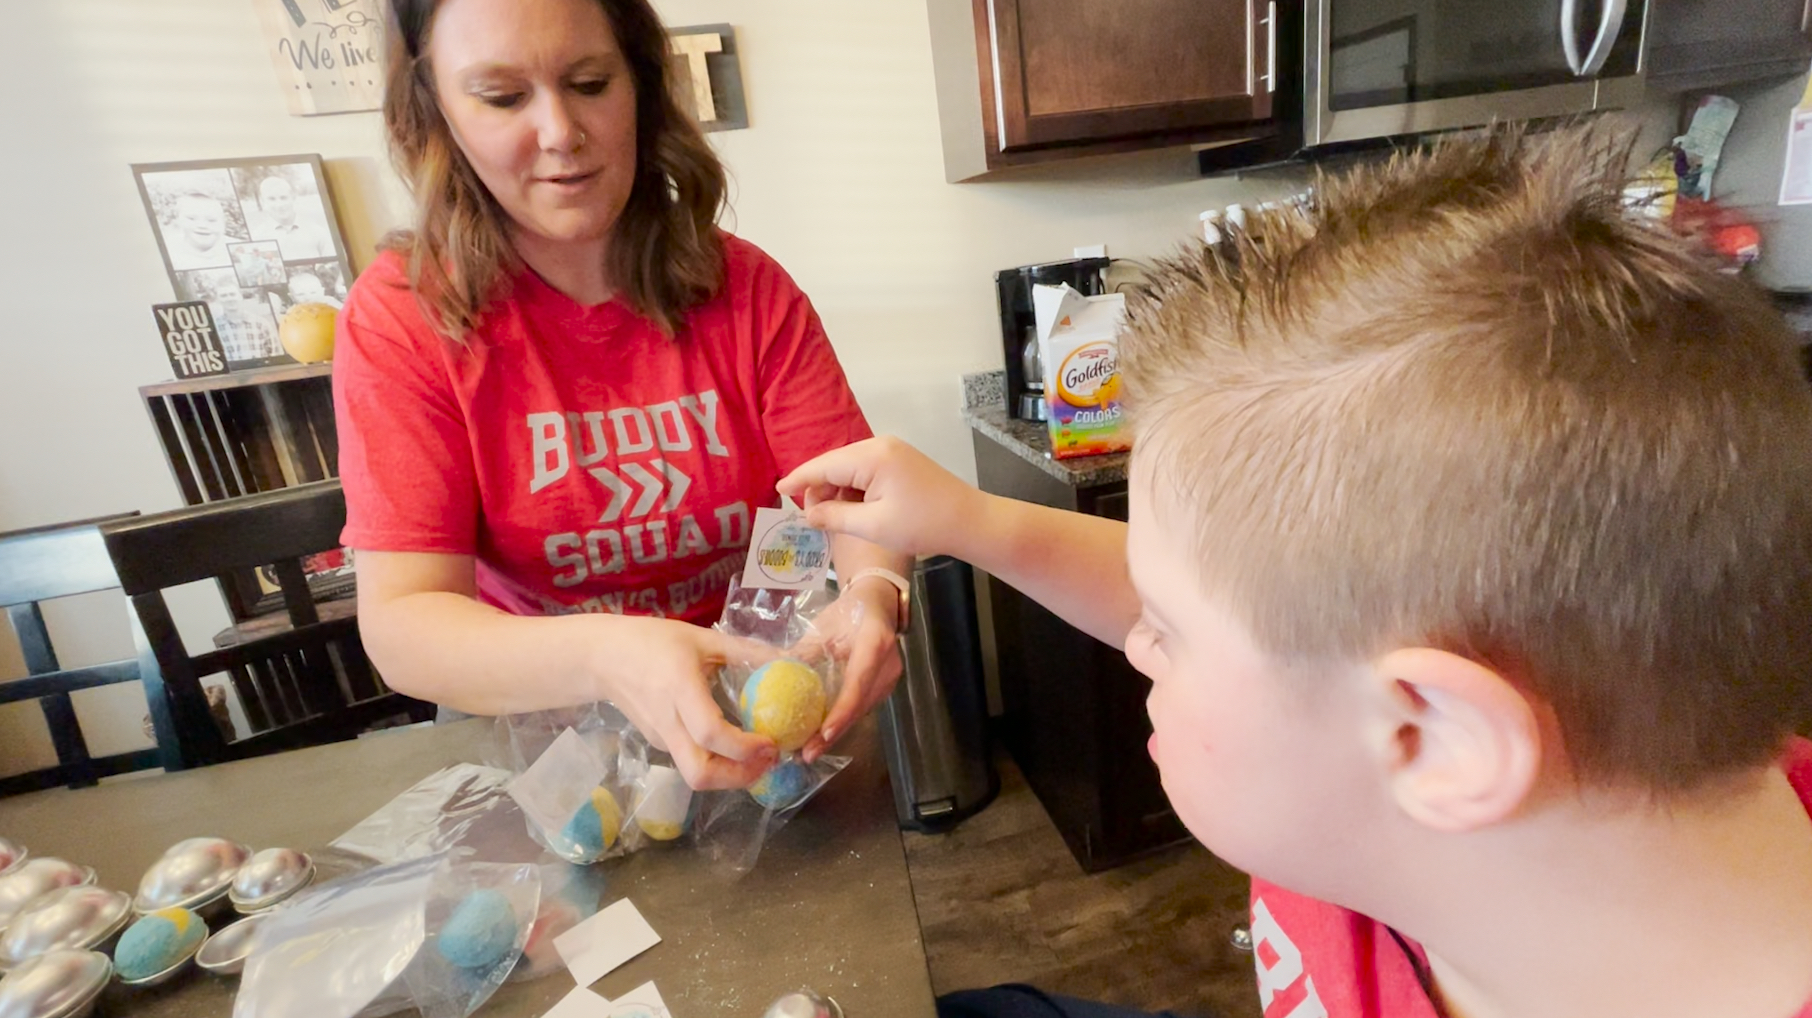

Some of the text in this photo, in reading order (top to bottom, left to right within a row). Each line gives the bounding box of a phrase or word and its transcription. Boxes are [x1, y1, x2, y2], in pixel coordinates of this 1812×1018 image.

[279, 32, 334, 71] We
[670, 33, 722, 122] T
[158, 305, 209, 331] YOU
[166, 328, 211, 356] GOT
[175, 351, 224, 376] THIS
[1075, 405, 1121, 424] COLORS
[527, 389, 729, 494] BUDDY
[544, 501, 749, 588] SQUAD
